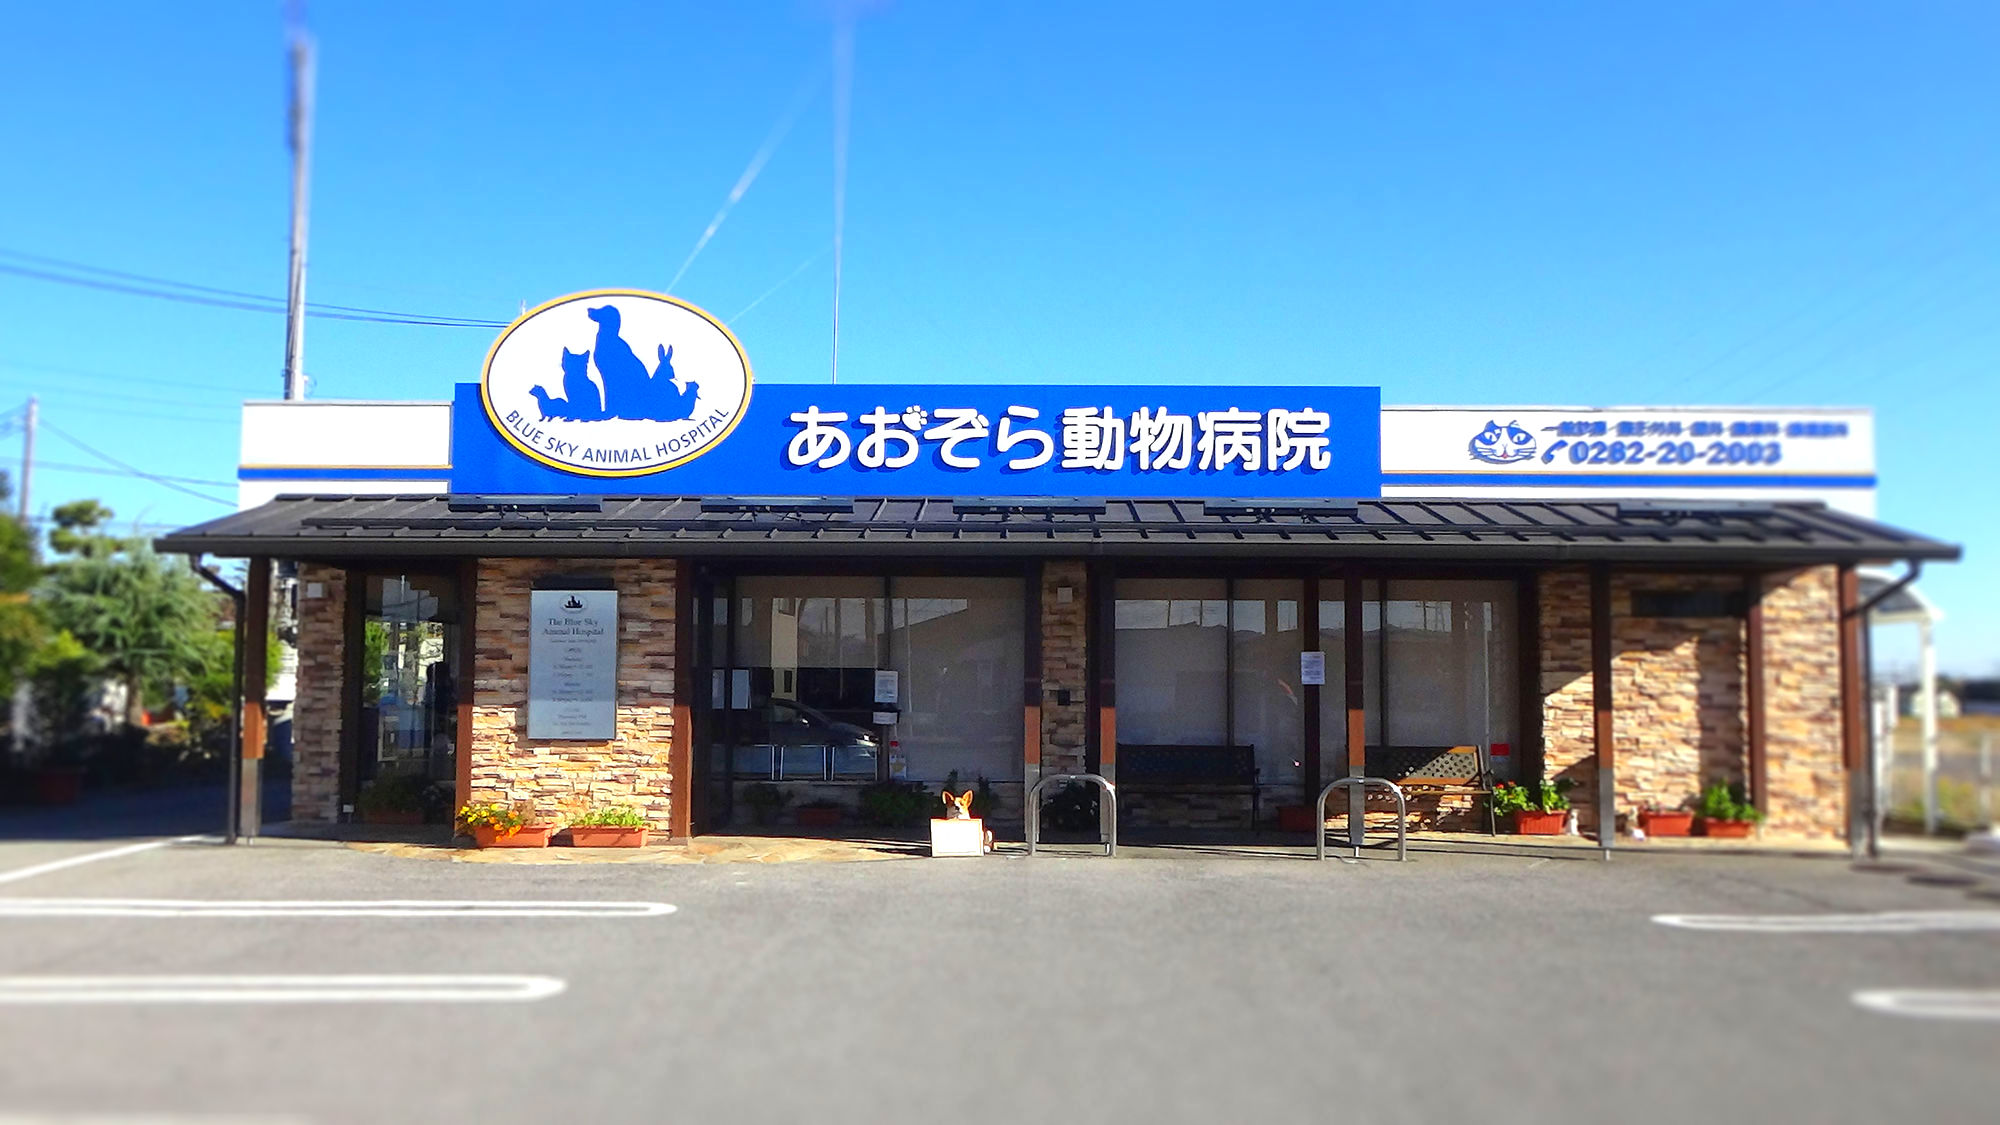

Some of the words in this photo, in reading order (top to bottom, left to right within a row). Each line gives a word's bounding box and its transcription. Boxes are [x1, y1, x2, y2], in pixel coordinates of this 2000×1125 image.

[506, 410, 545, 445] BLUE
[546, 437, 580, 459] SKY
[581, 447, 652, 464] ANIMAL
[655, 409, 729, 458] HOSPITAL
[788, 405, 1332, 471] あおぞら動物病院
[1569, 440, 1782, 464] 0282-20-2003
[572, 628, 604, 637] Hospital
[585, 618, 599, 627] Sky
